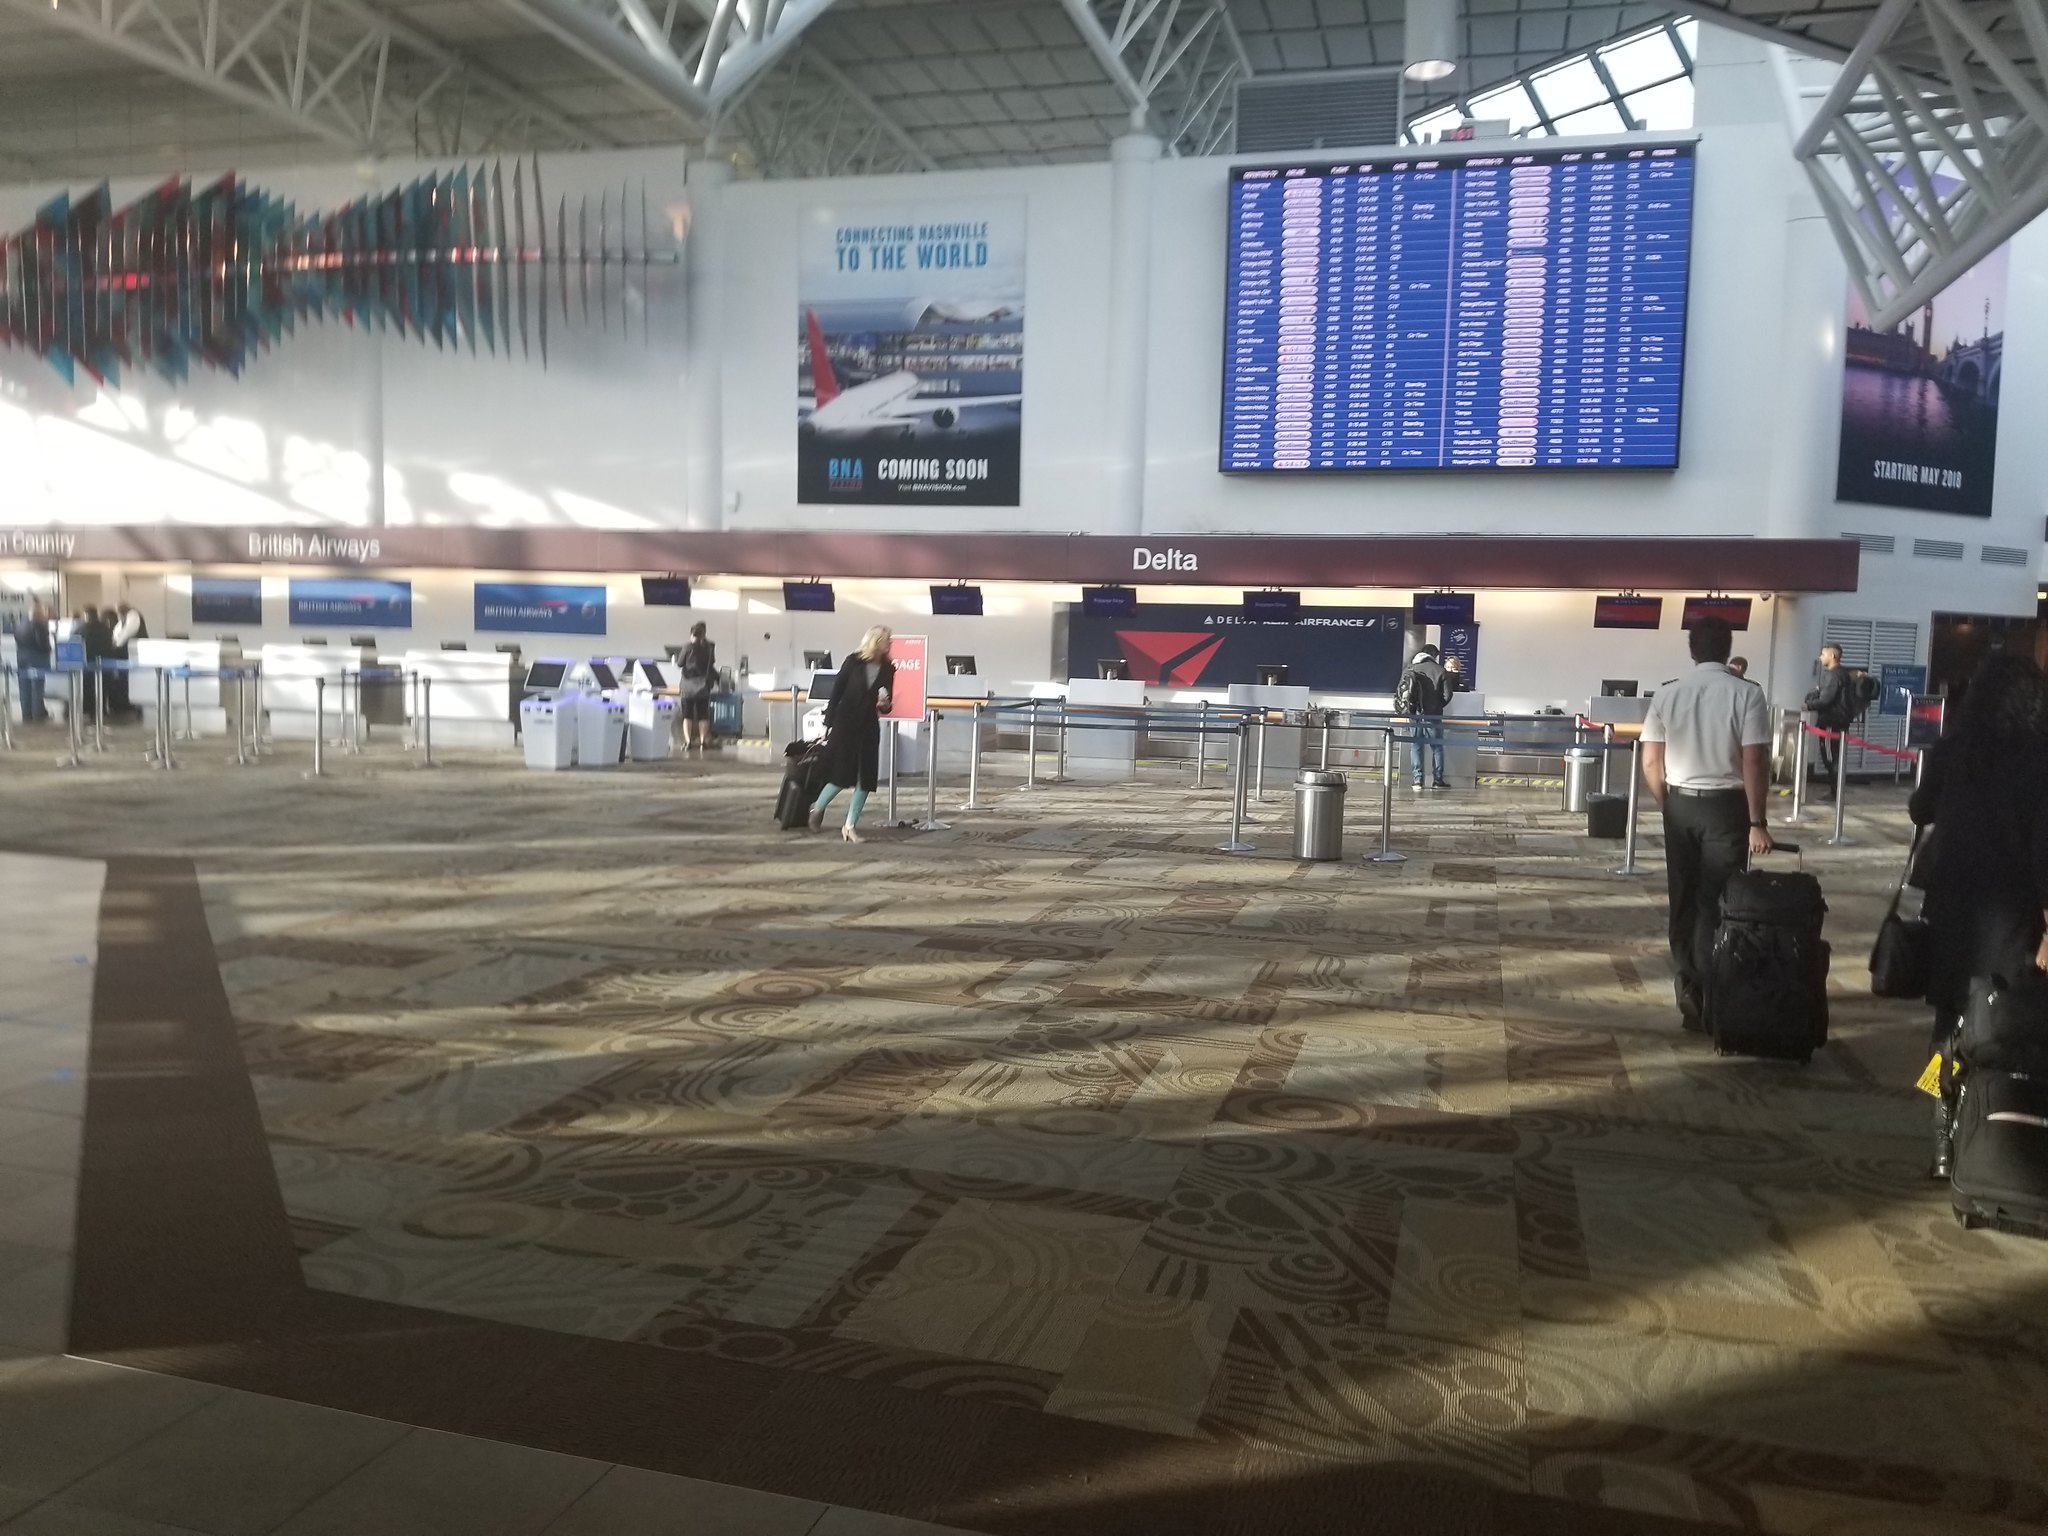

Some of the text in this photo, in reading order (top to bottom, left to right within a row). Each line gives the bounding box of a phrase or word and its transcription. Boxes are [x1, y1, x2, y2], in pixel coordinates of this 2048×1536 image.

[837, 221, 988, 243] CONNECTING NASHVILLE
[837, 241, 987, 271] TO THE WORLD
[829, 457, 988, 481] BNA COMING SOON
[1874, 459, 1962, 489] STARTING MAY 2018
[13, 529, 75, 558] Country
[249, 531, 380, 563] British Airways
[1133, 547, 1198, 571] Delta
[484, 605, 553, 618] BRITISH AIRWAYS
